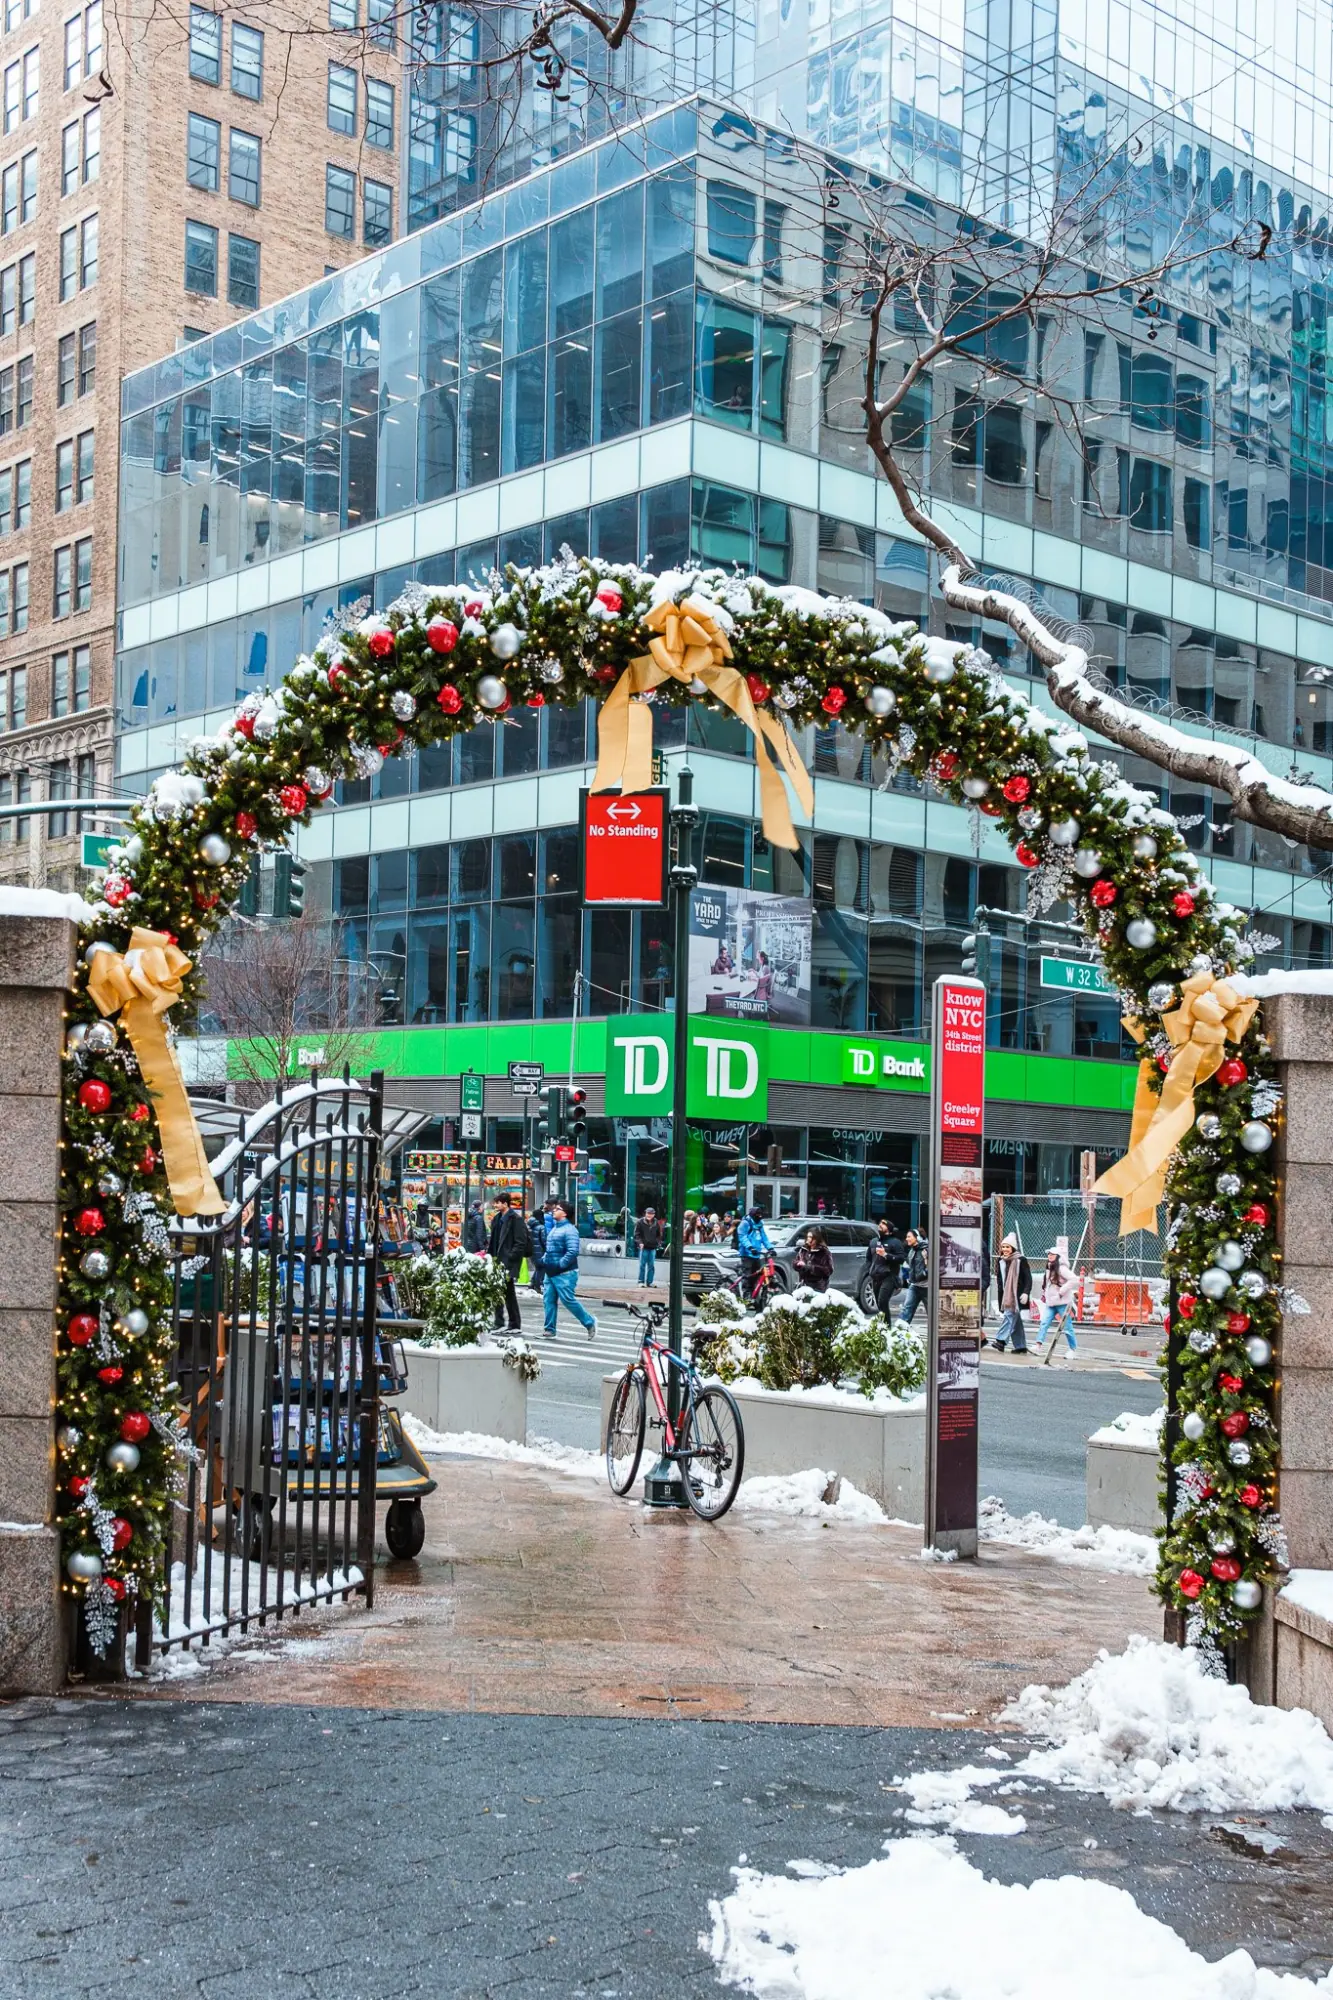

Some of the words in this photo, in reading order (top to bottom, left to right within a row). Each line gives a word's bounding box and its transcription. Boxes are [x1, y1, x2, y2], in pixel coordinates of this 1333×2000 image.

[589, 825, 605, 836] No
[608, 824, 659, 839] Standing
[702, 895, 712, 903] THE
[694, 901, 721, 919] YARD
[1065, 966, 1075, 983] W
[1077, 968, 1091, 986] 32
[725, 1000, 765, 1012] THEYARD.NYC
[945, 988, 983, 1007] know
[945, 1007, 982, 1028] NYC
[945, 1029, 960, 1040] 34th
[961, 1031, 982, 1041] Street
[298, 1047, 327, 1065] Bank
[945, 1040, 982, 1055] district
[613, 1035, 669, 1094] TD
[693, 1036, 759, 1099] TD
[848, 1048, 875, 1076] TD
[883, 1055, 925, 1078] Bank
[944, 1101, 981, 1117] Greeley
[943, 1113, 976, 1128] Square
[408, 1153, 478, 1170] OPEN
